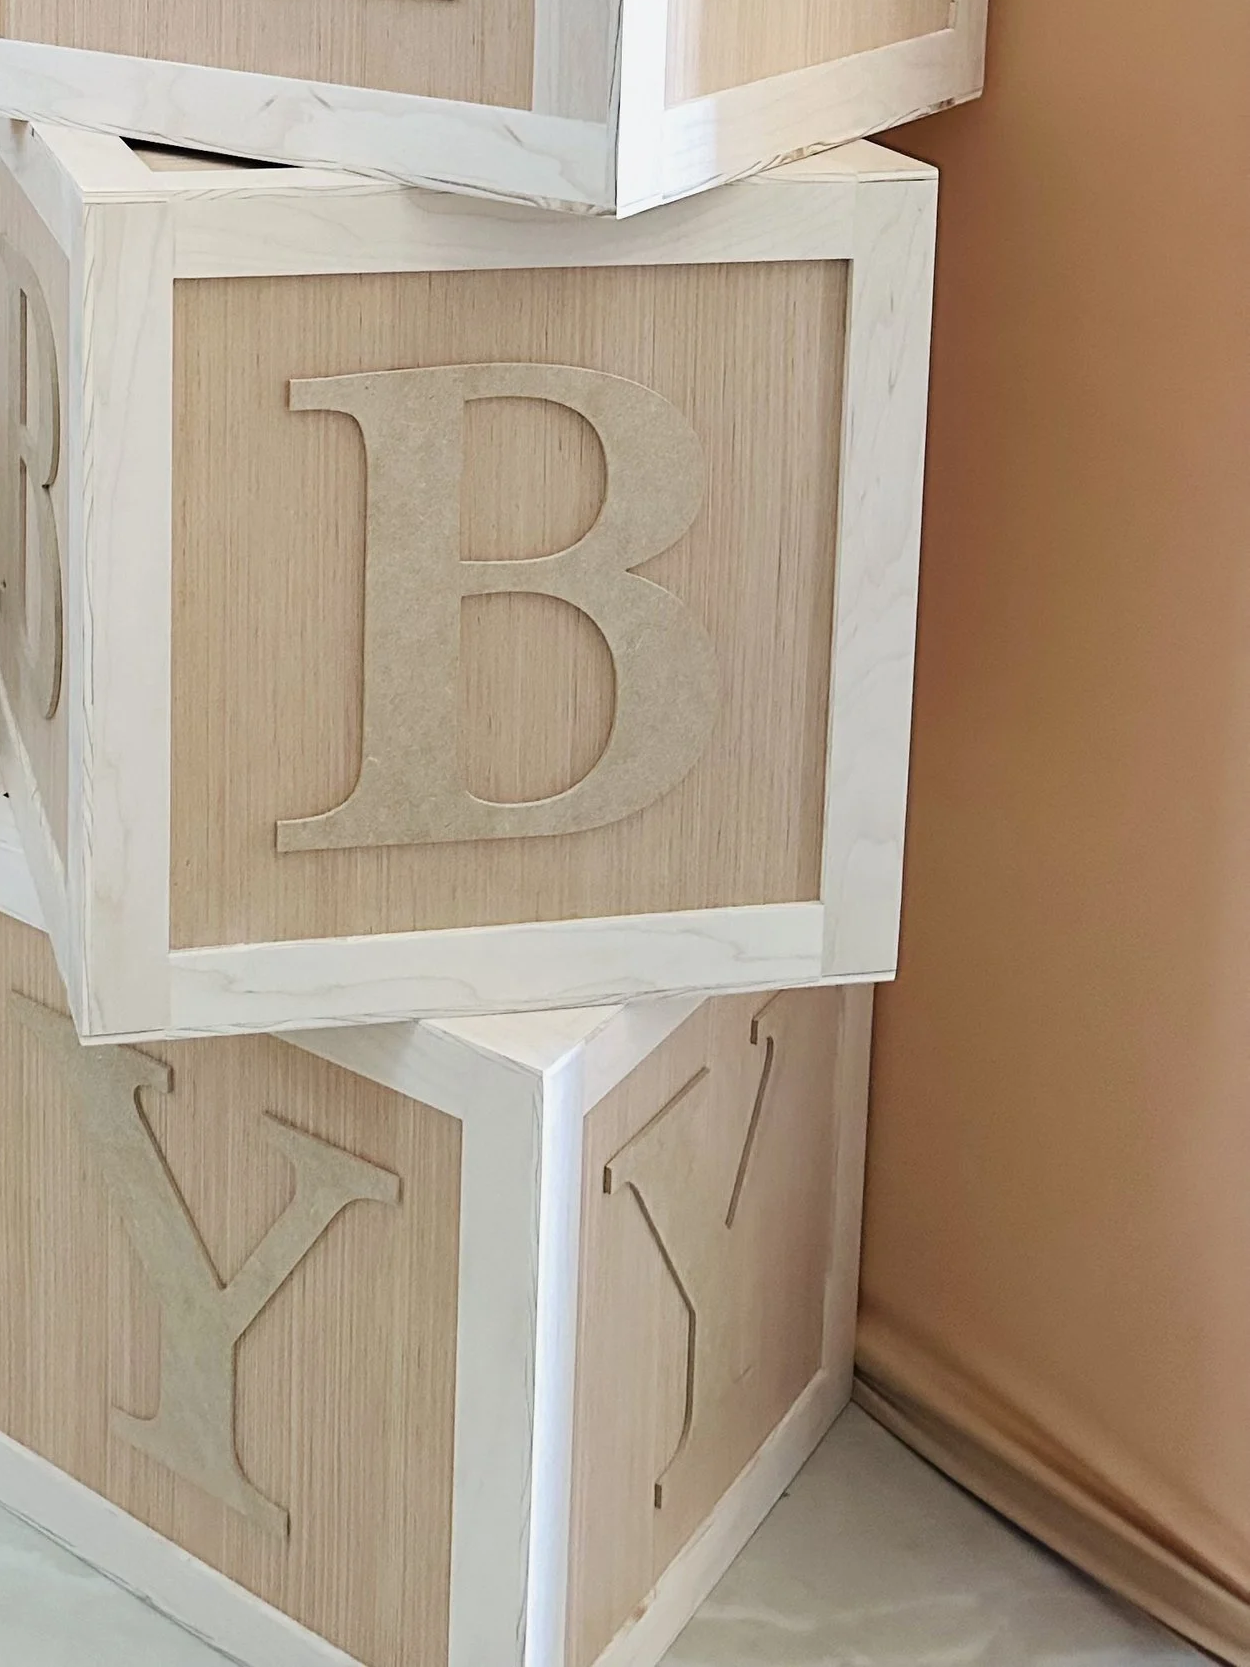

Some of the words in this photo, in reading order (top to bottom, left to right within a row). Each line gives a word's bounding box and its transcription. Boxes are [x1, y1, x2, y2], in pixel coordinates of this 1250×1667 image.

[276, 361, 718, 852] B
[10, 989, 402, 1537] Y
[603, 989, 802, 1510] Y
